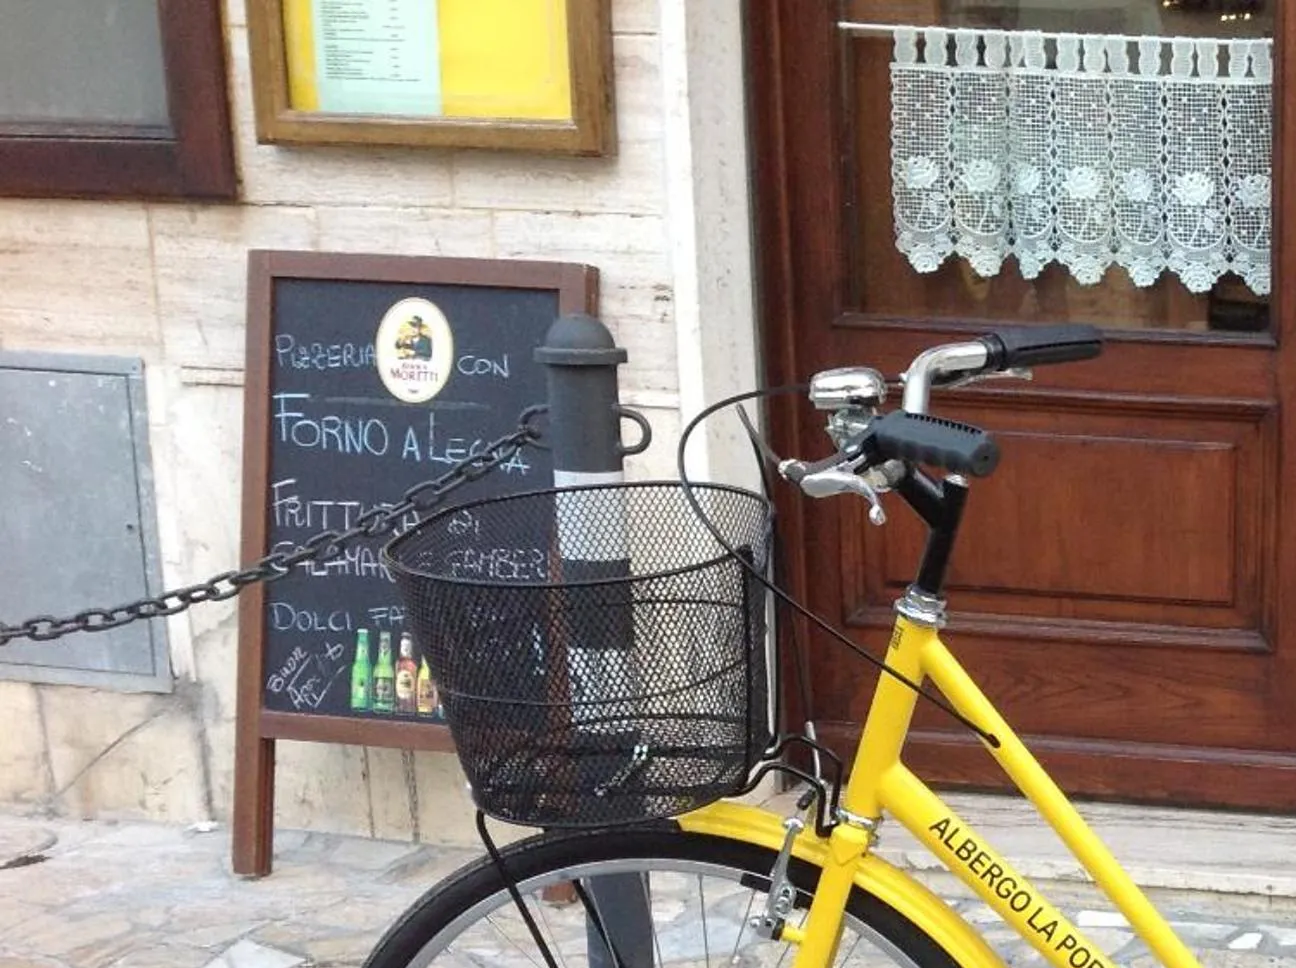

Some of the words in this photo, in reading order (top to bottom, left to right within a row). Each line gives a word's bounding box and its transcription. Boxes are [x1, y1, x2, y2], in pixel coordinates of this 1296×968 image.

[390, 367, 439, 382] MORETTI
[457, 354, 511, 378] CON
[272, 393, 389, 456] FORNO
[402, 426, 421, 461] A
[270, 602, 352, 632] DOLCI
[929, 817, 1032, 914] ALBERGO
[1026, 907, 1056, 943] LA
